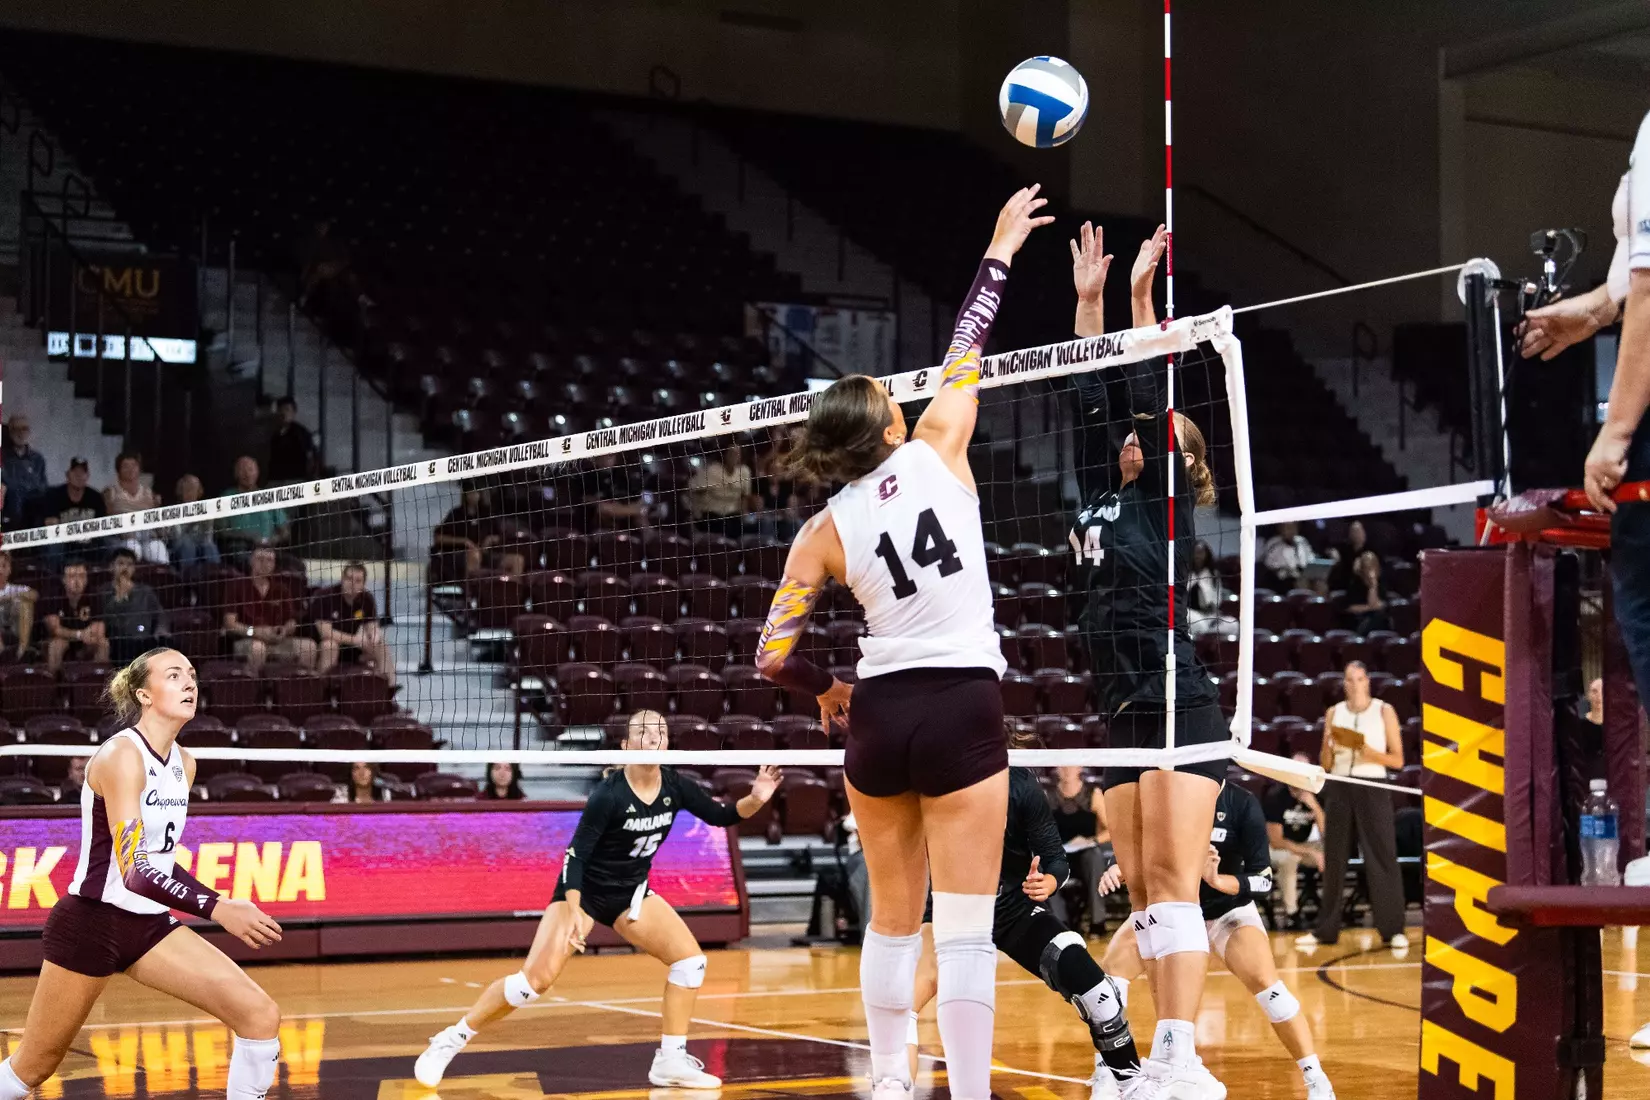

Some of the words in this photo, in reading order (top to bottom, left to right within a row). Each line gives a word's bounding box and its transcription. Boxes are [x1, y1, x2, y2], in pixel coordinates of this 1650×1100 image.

[997, 345, 1053, 376] MICHIGAN
[1056, 333, 1125, 367] VOLLEYBALL
[749, 401, 787, 421] CENTRAL
[586, 430, 617, 450] CENTRAL
[619, 420, 657, 444] MICHIGAN
[658, 411, 706, 437] VOLLEYBALL
[447, 457, 474, 474] CENTRAL
[476, 449, 508, 467] MICHIGAN
[509, 441, 549, 463] VOLLEYBALL
[331, 477, 354, 493] CENTRAL
[355, 470, 382, 489] MICHIGAN
[383, 465, 417, 484] VOLLEYBALL
[230, 495, 250, 510] CENTRAL
[251, 490, 275, 506] MICHIGAN
[276, 485, 304, 502] VOLLEYBALL
[874, 507, 964, 600] 14
[1068, 525, 1105, 567] 14
[158, 821, 176, 854] 6
[622, 812, 673, 832] OAKLAND
[628, 832, 663, 858] 15
[1421, 617, 1518, 1100] CHIPPE
